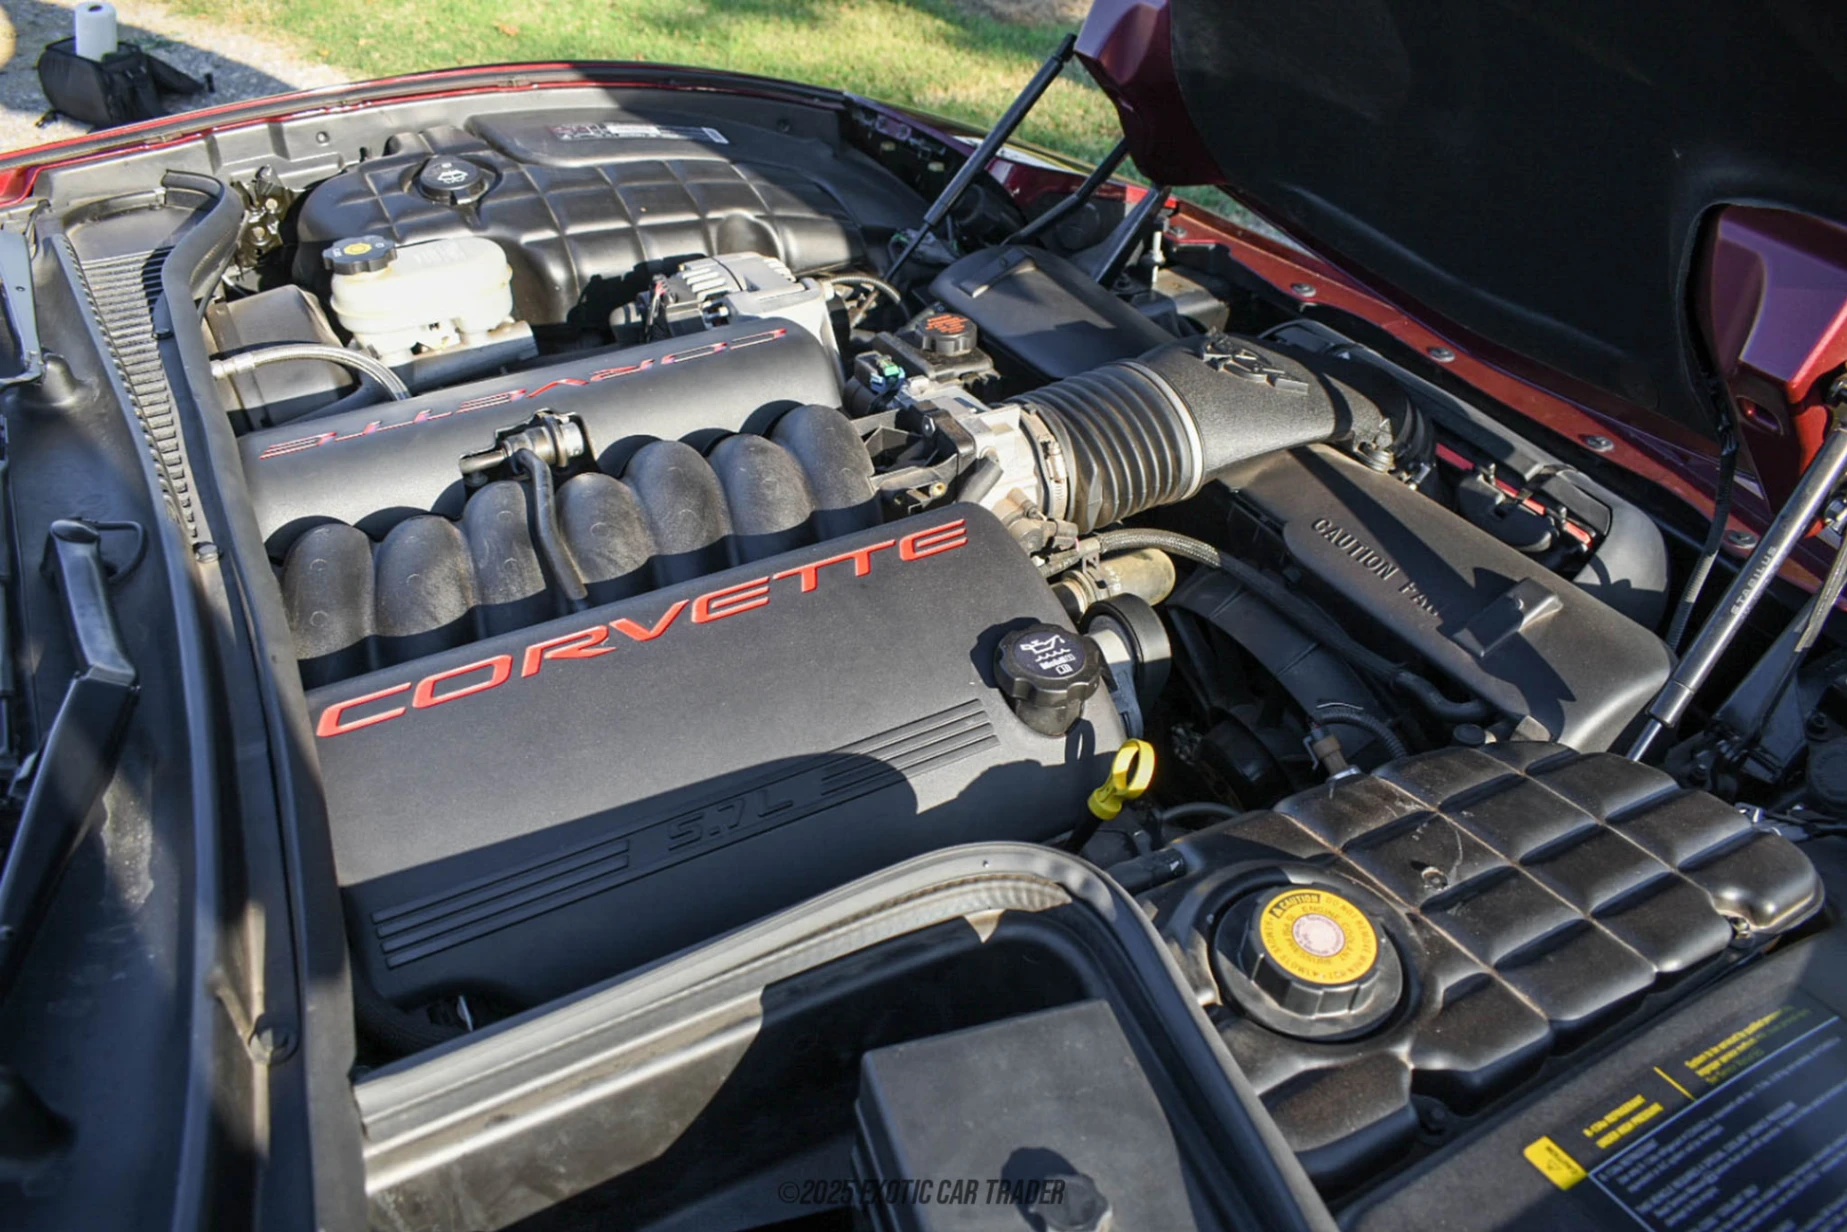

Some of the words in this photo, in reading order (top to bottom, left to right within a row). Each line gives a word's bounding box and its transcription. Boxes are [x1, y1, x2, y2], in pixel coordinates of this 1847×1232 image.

[1311, 518, 1399, 581] CAUTION
[1730, 546, 1777, 616] STABILUS
[316, 518, 968, 737] CORVETTE
[668, 789, 795, 851] 5.7L
[1281, 894, 1320, 910] CAUTION
